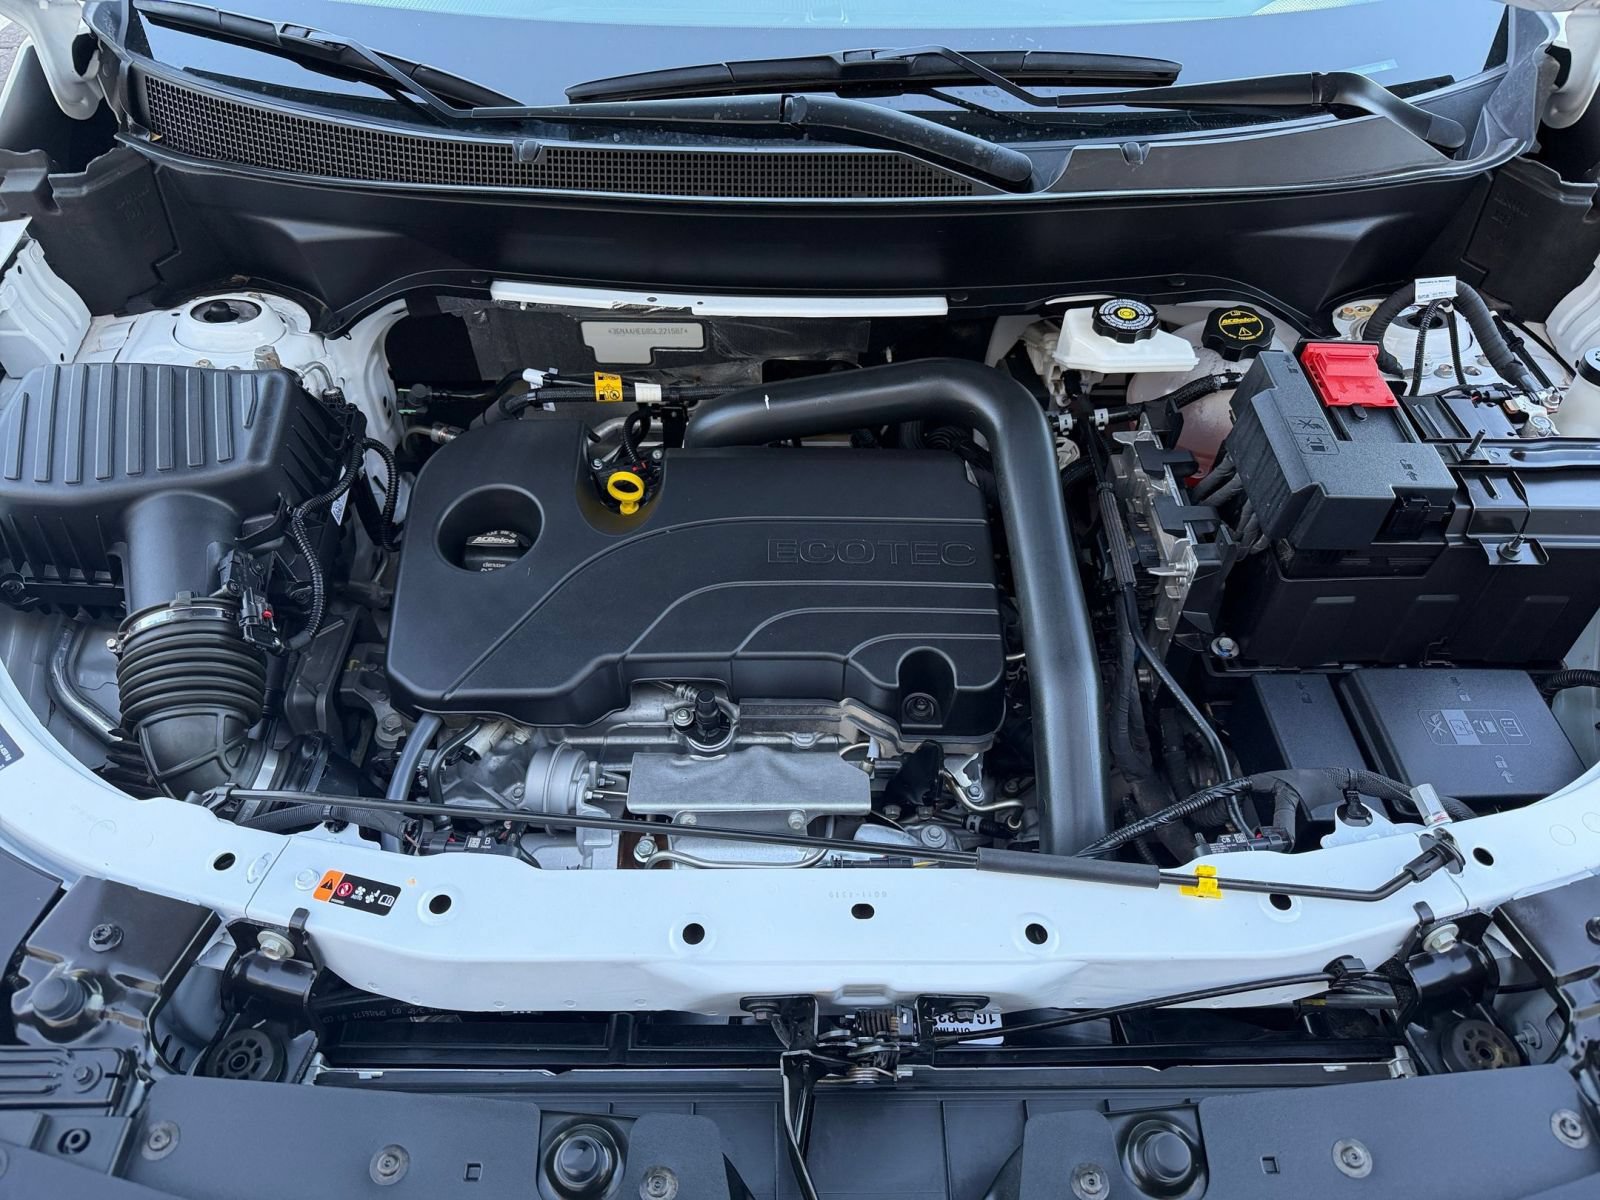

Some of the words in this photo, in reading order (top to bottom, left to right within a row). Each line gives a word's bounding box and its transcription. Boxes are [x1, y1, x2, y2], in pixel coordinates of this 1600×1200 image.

[1221, 316, 1258, 326] ACDelco
[471, 536, 516, 544] ACDelco
[767, 539, 977, 566] ECOTEC
